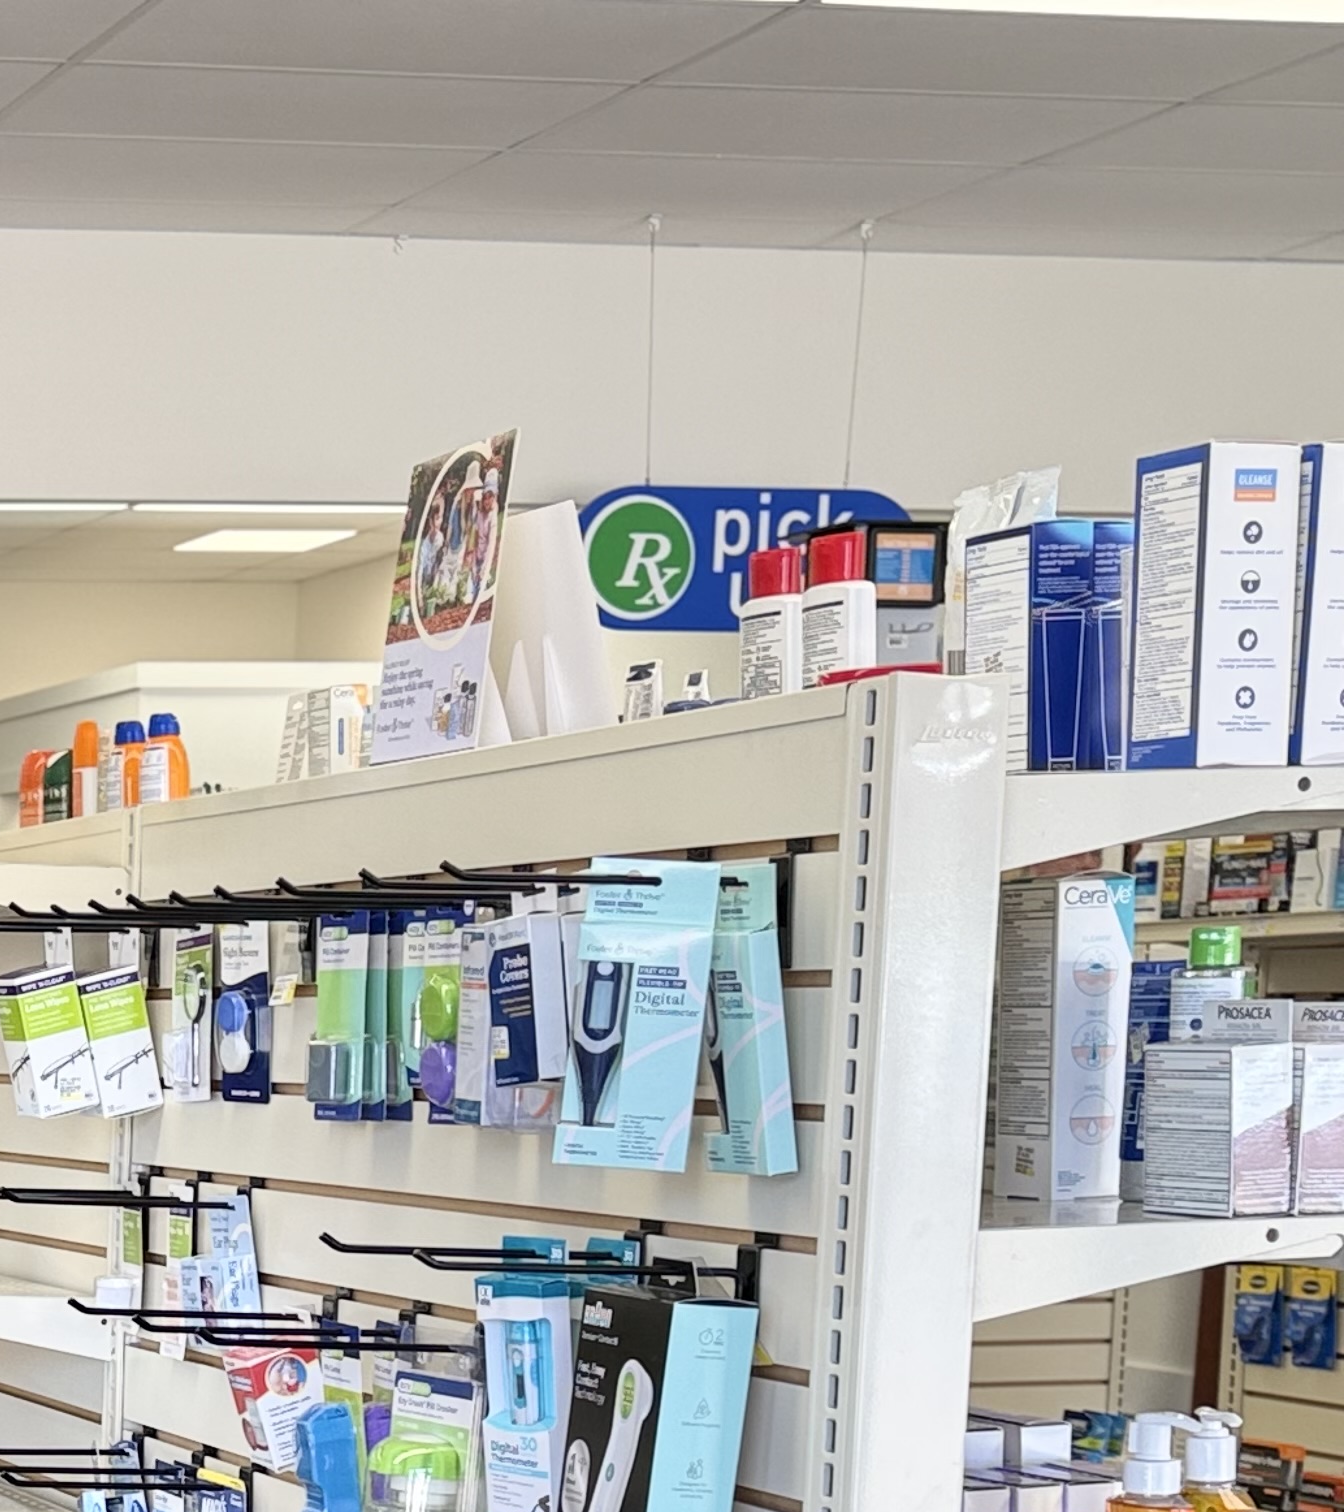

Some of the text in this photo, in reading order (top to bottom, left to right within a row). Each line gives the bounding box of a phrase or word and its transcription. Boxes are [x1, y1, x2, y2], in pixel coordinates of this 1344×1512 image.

[615, 532, 681, 606] Rx
[1064, 885, 1133, 906] CeraVe
[503, 955, 528, 969] Probe
[499, 969, 530, 983] Covers
[24, 996, 70, 1015] Lens Wipes
[88, 995, 134, 1015] Lens Wipes
[634, 991, 686, 1007] Digital
[633, 1006, 702, 1018] Thermometer
[1217, 1005, 1272, 1021] PROSACEA
[1300, 1007, 1344, 1022] PROSACE
[715, 1329, 724, 1342] 2
[490, 1436, 537, 1455] Digital 30
[490, 1452, 539, 1469] Thermometer
